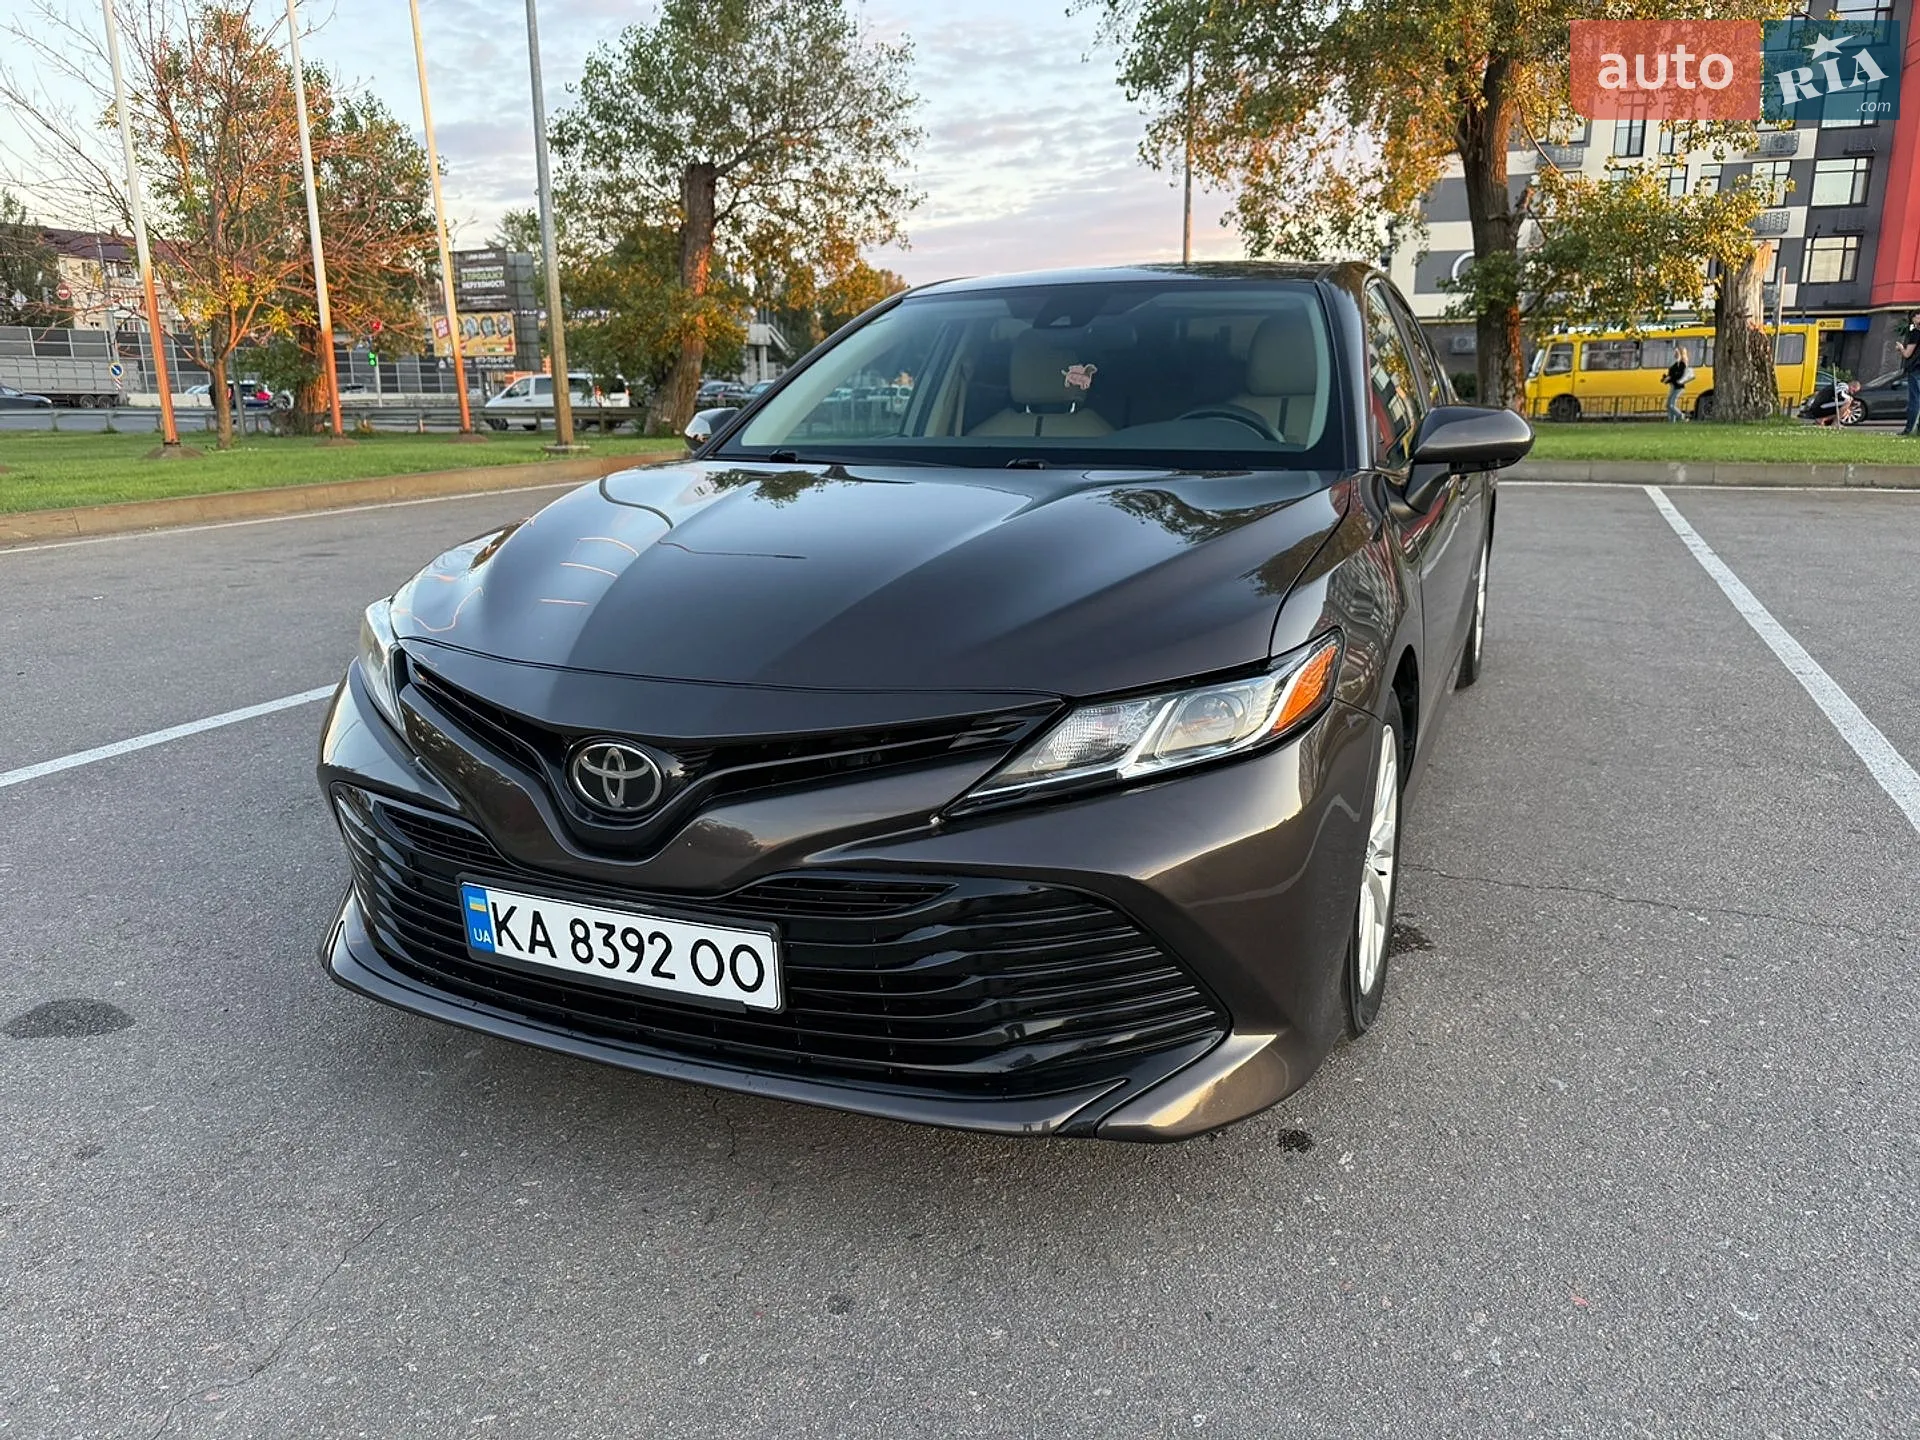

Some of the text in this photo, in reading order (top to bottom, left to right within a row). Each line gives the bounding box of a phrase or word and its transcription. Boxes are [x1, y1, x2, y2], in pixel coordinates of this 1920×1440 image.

[473, 927, 492, 944] UA
[491, 901, 765, 992] KA 8392 OO
